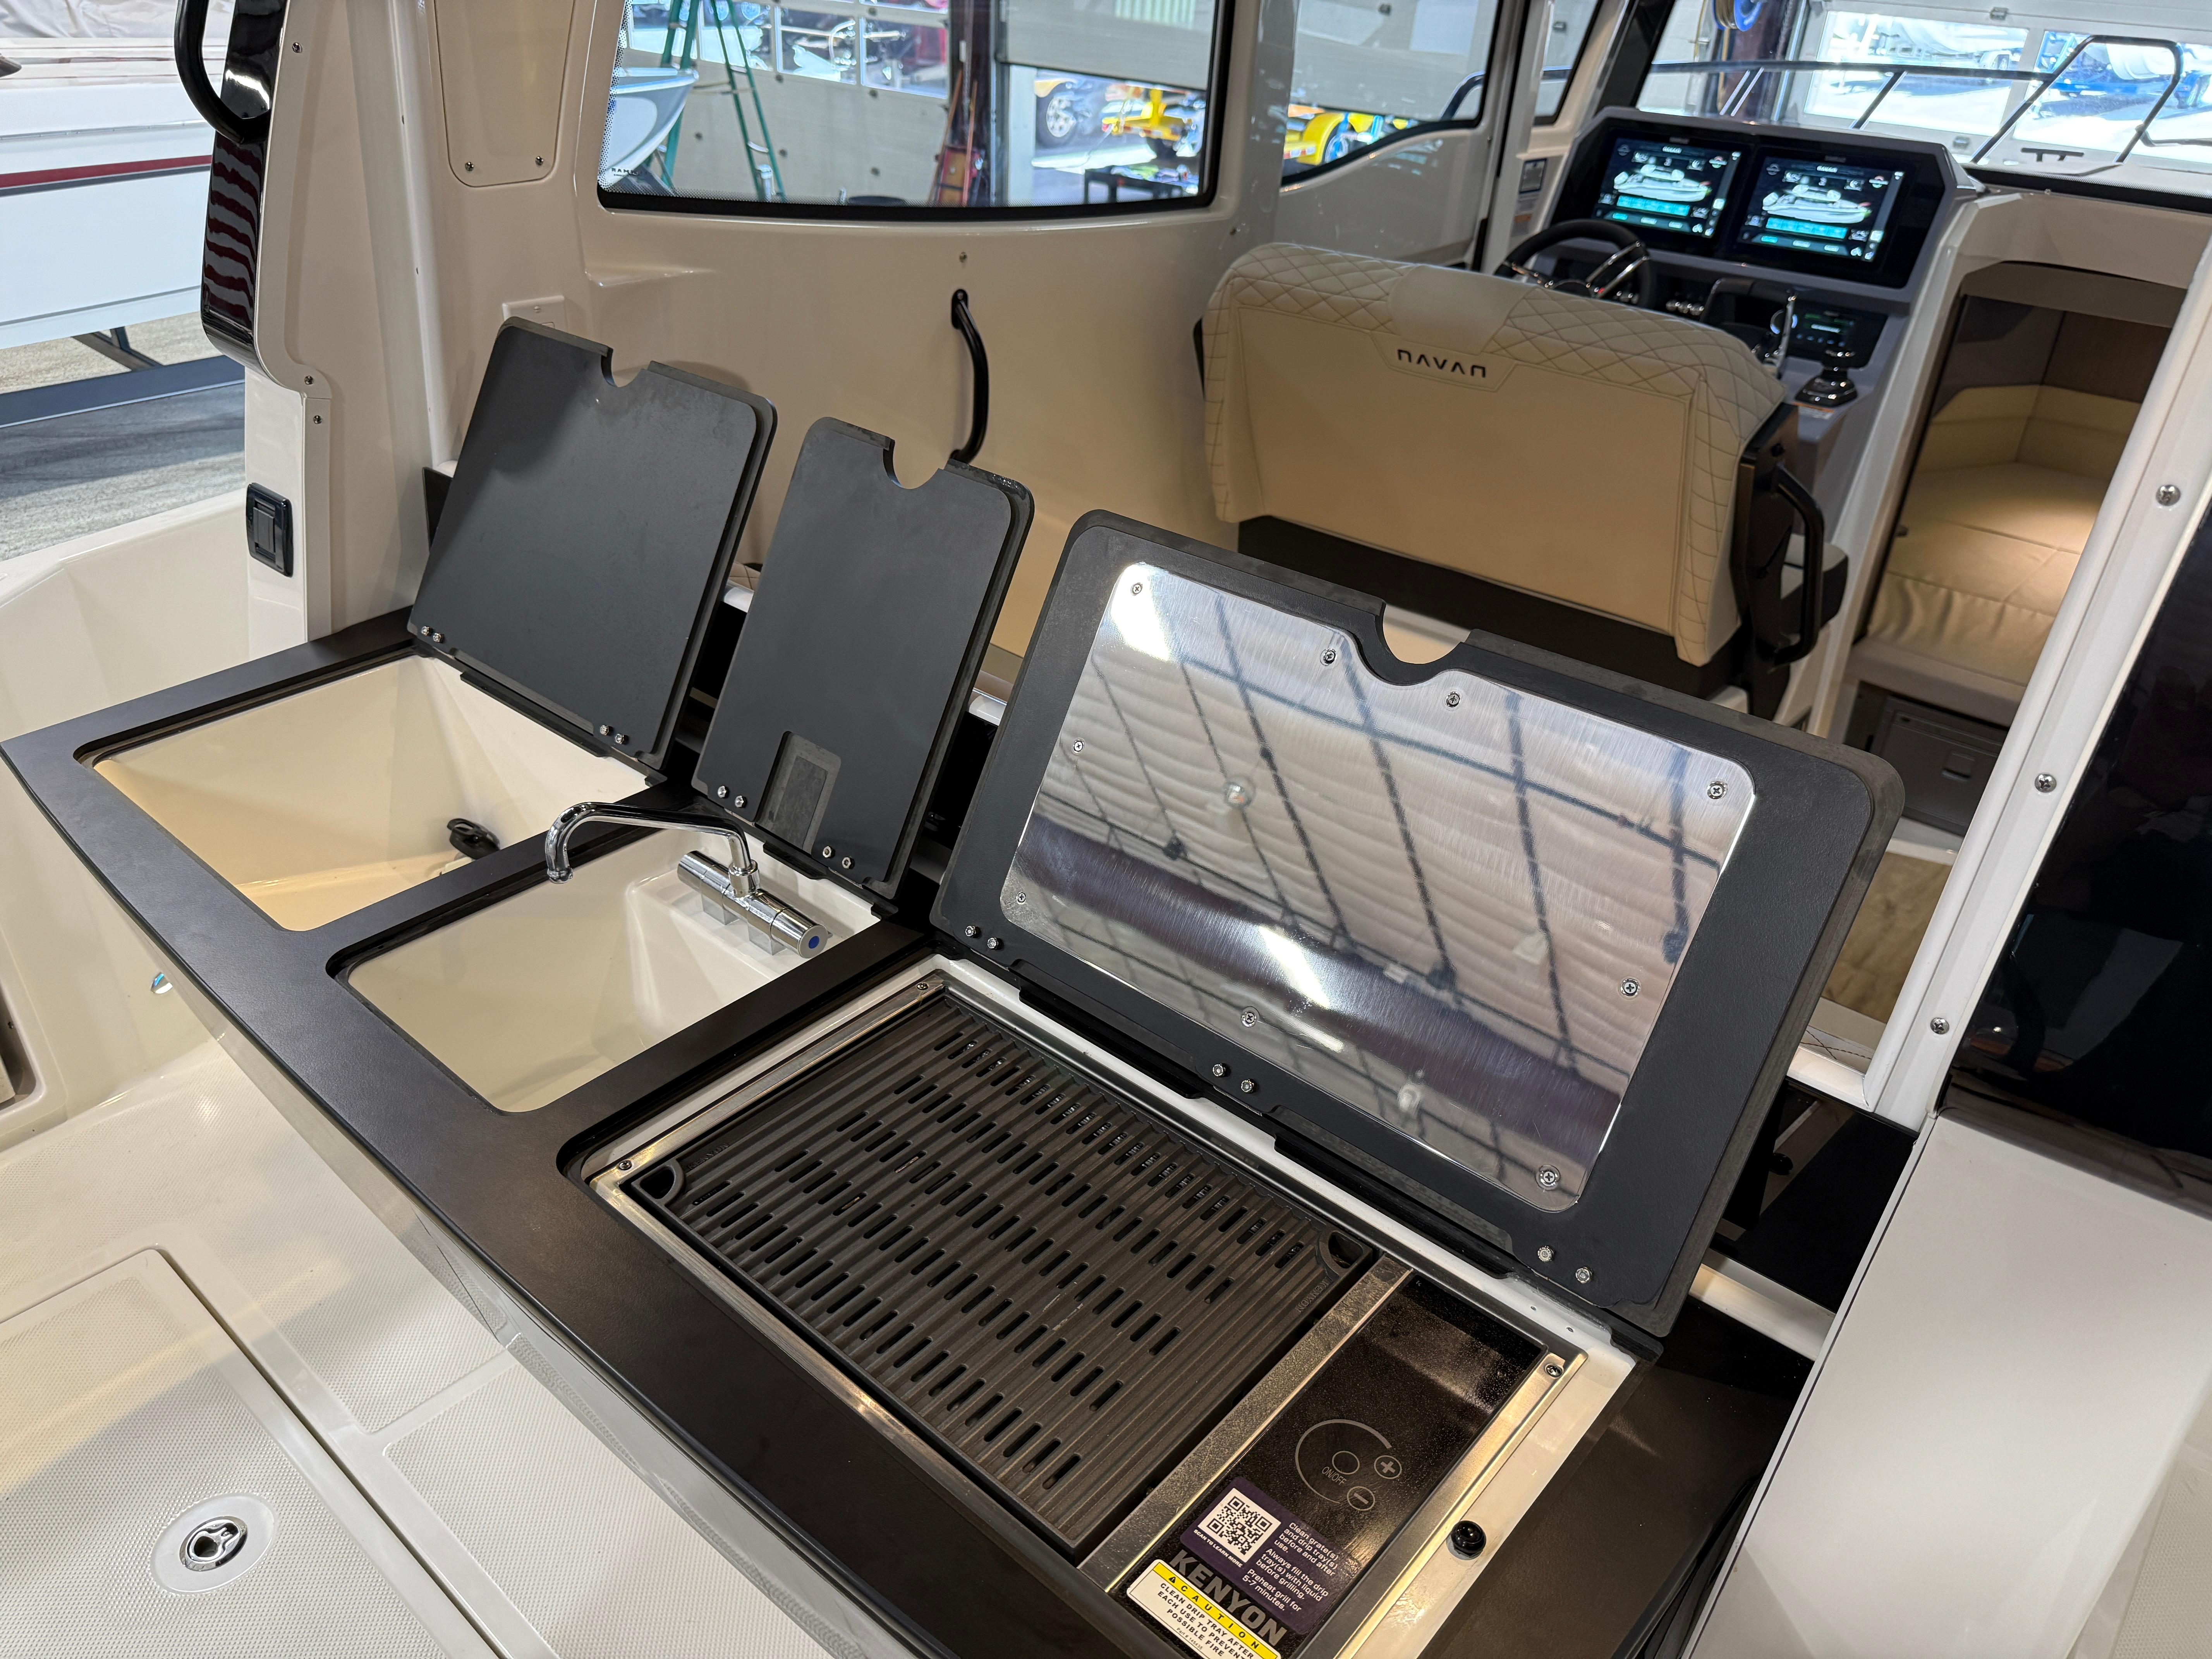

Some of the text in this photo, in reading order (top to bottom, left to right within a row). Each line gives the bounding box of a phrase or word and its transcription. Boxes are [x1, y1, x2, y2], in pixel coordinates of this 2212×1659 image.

[1295, 1276, 1331, 1312] KENYON
[1322, 1467, 1347, 1485] ON/OFF
[1194, 1529, 1207, 1540] SCAN
[1212, 1544, 1229, 1557] LEARN
[1228, 1556, 1243, 1568] MORE
[1274, 1540, 1288, 1553] use.
[1279, 1533, 1336, 1576] before and after
[1284, 1529, 1338, 1570] and drip tray(s)
[1289, 1522, 1338, 1561] Clean grate(s)
[1242, 1575, 1285, 1611] 5-7 minutes.
[1247, 1569, 1302, 1611] Preheat grill for
[1256, 1559, 1305, 1600] before grilling.
[1261, 1554, 1323, 1602] tray(s) with liquid
[1266, 1548, 1329, 1597] Always fill the drip
[1158, 1591, 1179, 1609] EACH
[1180, 1609, 1196, 1623] USE
[1197, 1622, 1207, 1632] TO
[1169, 1549, 1288, 1646] KENYON
[1181, 1585, 1259, 1649] CAUTION
[1160, 1583, 1254, 1659] CLEAN DRIP TRAY AFTER
[1166, 1609, 1224, 1657] POSSIBLE FIRE
[1176, 1627, 1185, 1635] Part
